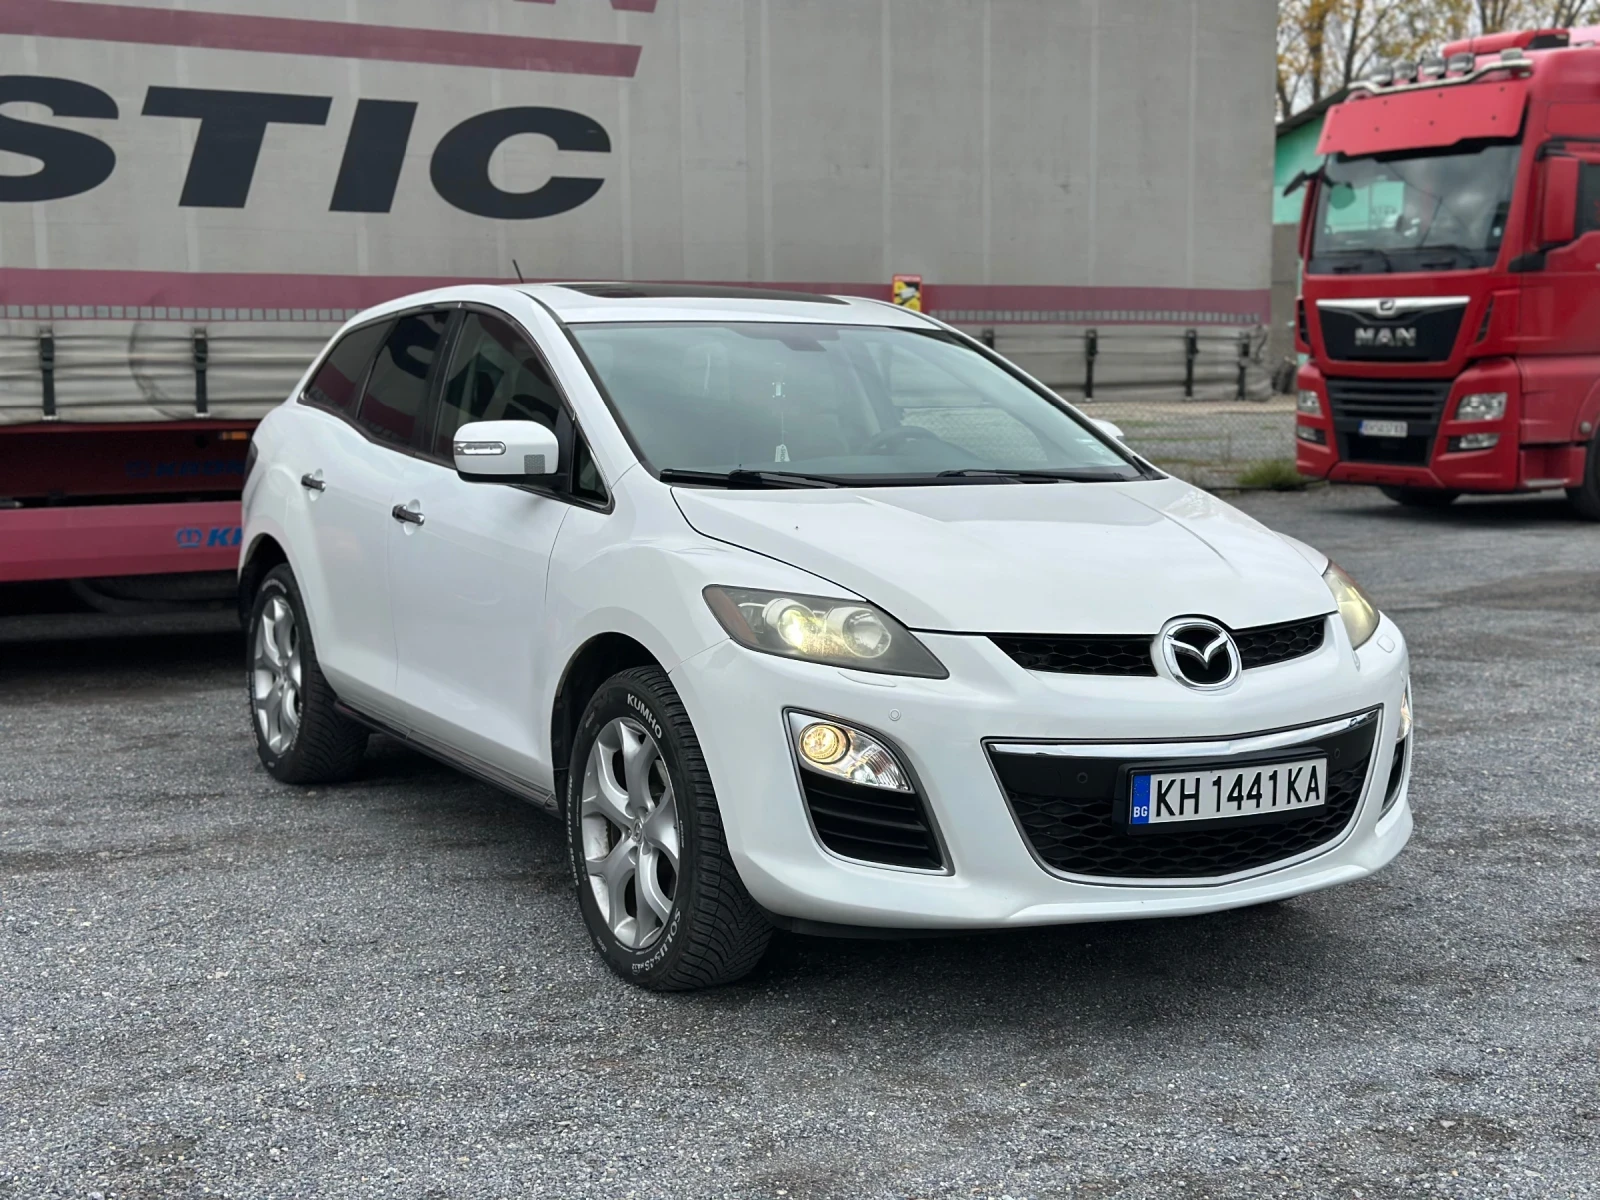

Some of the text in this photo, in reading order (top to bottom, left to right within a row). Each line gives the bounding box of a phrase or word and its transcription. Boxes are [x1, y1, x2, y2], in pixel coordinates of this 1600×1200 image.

[0, 75, 611, 220] STIC
[1355, 327, 1416, 346] MAN
[626, 693, 662, 739] KUMHO
[1133, 806, 1148, 818] BG
